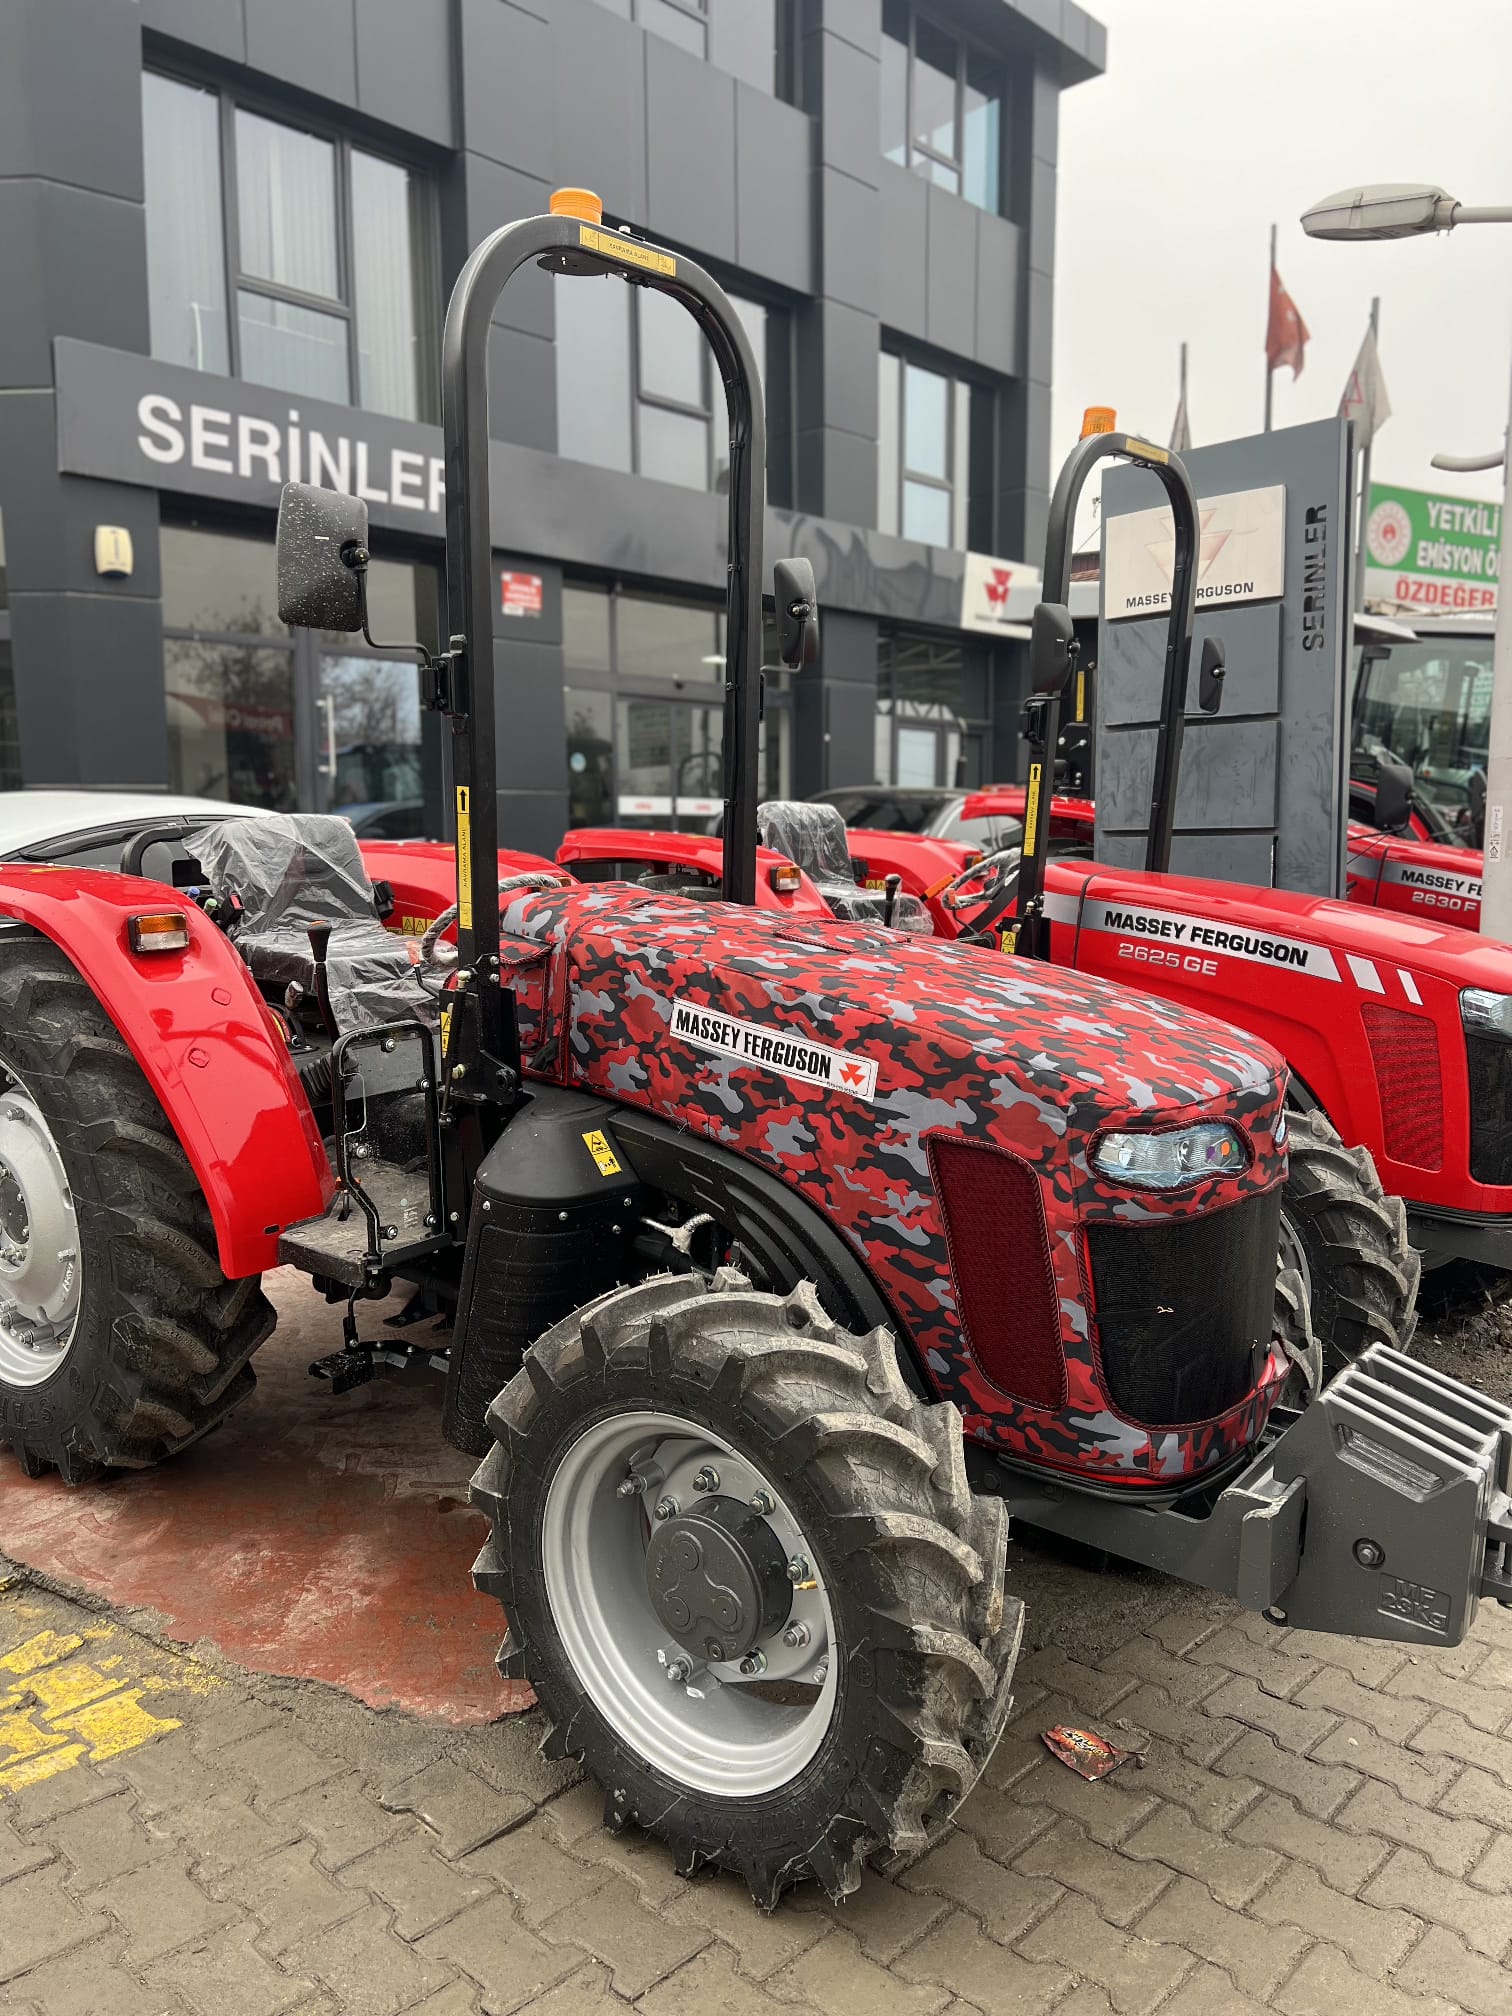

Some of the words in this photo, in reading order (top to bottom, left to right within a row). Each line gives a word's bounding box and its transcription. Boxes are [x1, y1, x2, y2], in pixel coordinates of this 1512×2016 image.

[1426, 500, 1501, 538] YETKİLİ
[1416, 536, 1483, 575] EMİSYON
[1485, 543, 1501, 578] Ö
[1196, 582, 1255, 599] RGUSON
[1395, 575, 1496, 609] ÖZDEĞER
[1401, 869, 1466, 892] MASSEY
[1411, 891, 1462, 911] 2630
[1104, 910, 1187, 940] MASSEY
[1189, 925, 1309, 968] FERGUSON
[1117, 942, 1181, 969] 2625
[1183, 955, 1219, 977] GE
[675, 1008, 741, 1050] MASSEY
[743, 1032, 832, 1080] FERGUSON
